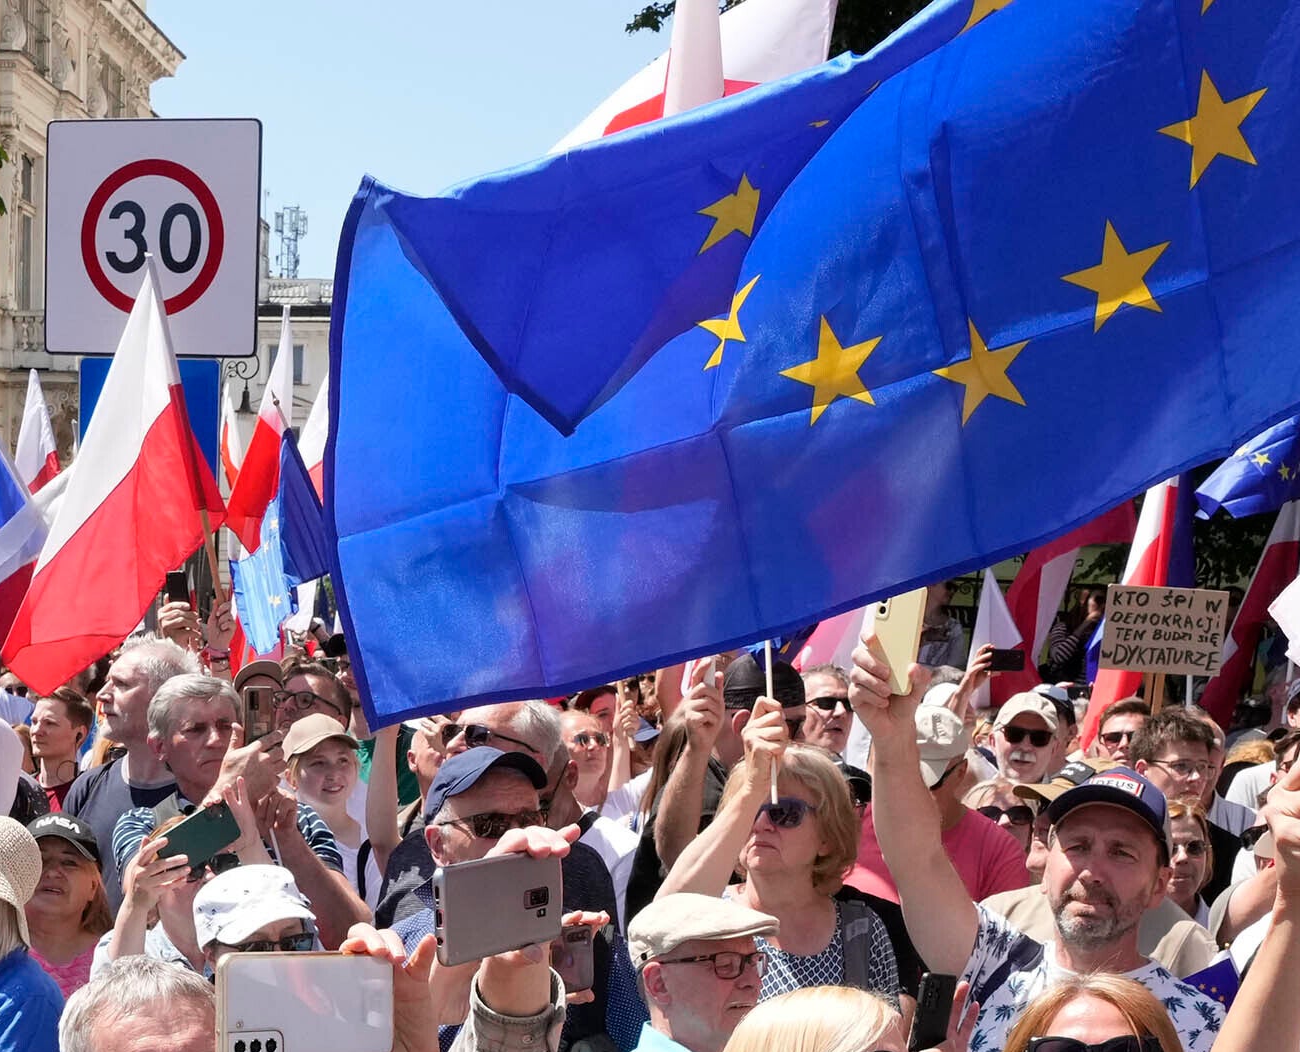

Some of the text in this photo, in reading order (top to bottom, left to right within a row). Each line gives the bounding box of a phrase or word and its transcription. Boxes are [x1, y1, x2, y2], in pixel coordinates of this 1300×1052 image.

[105, 200, 201, 274] 30
[1112, 591, 1150, 607] KTO
[1205, 599, 1223, 614] W
[1115, 627, 1147, 641] TEN
[1152, 629, 1192, 642] BUDZI
[36, 815, 81, 834] NASA
